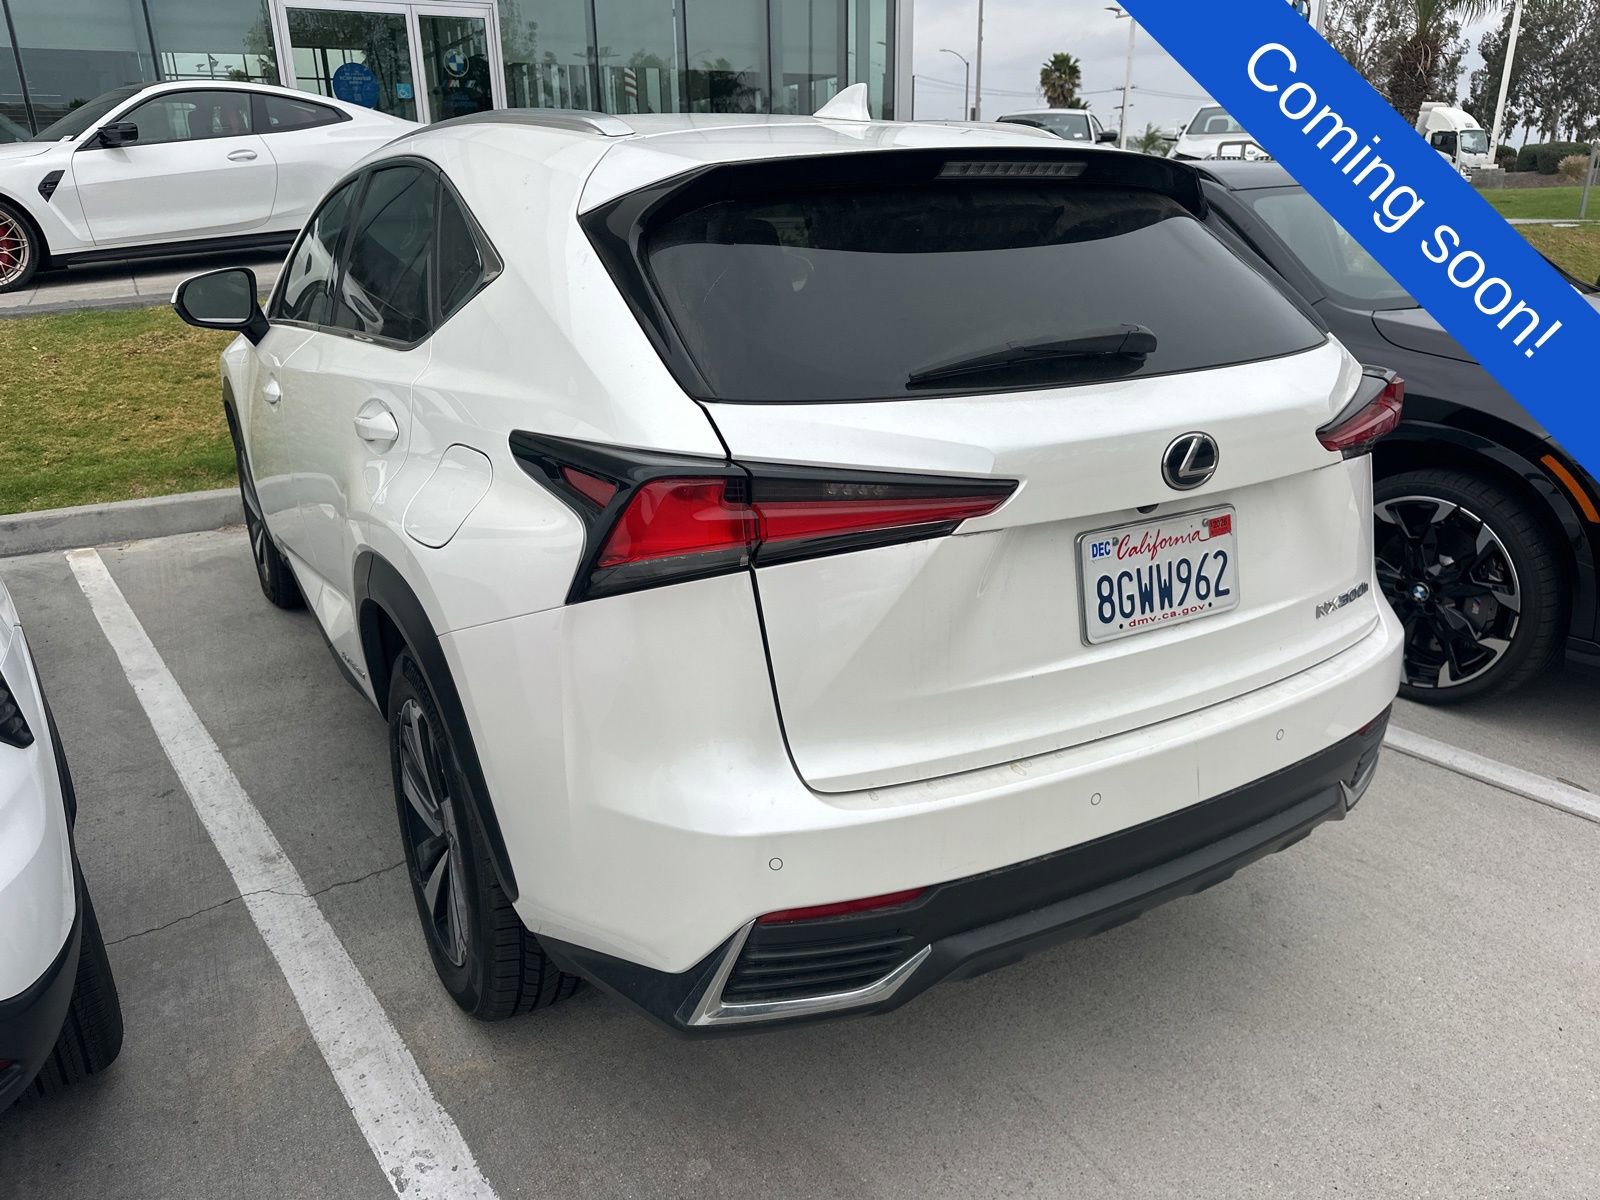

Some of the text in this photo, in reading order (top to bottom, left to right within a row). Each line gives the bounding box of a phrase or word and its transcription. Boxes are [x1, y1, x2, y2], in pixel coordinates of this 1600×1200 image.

[1091, 541, 1111, 558] DEC
[1116, 529, 1210, 560] California
[1096, 549, 1231, 625] 8GWW962
[1128, 603, 1206, 628] dmv.ca.gov
